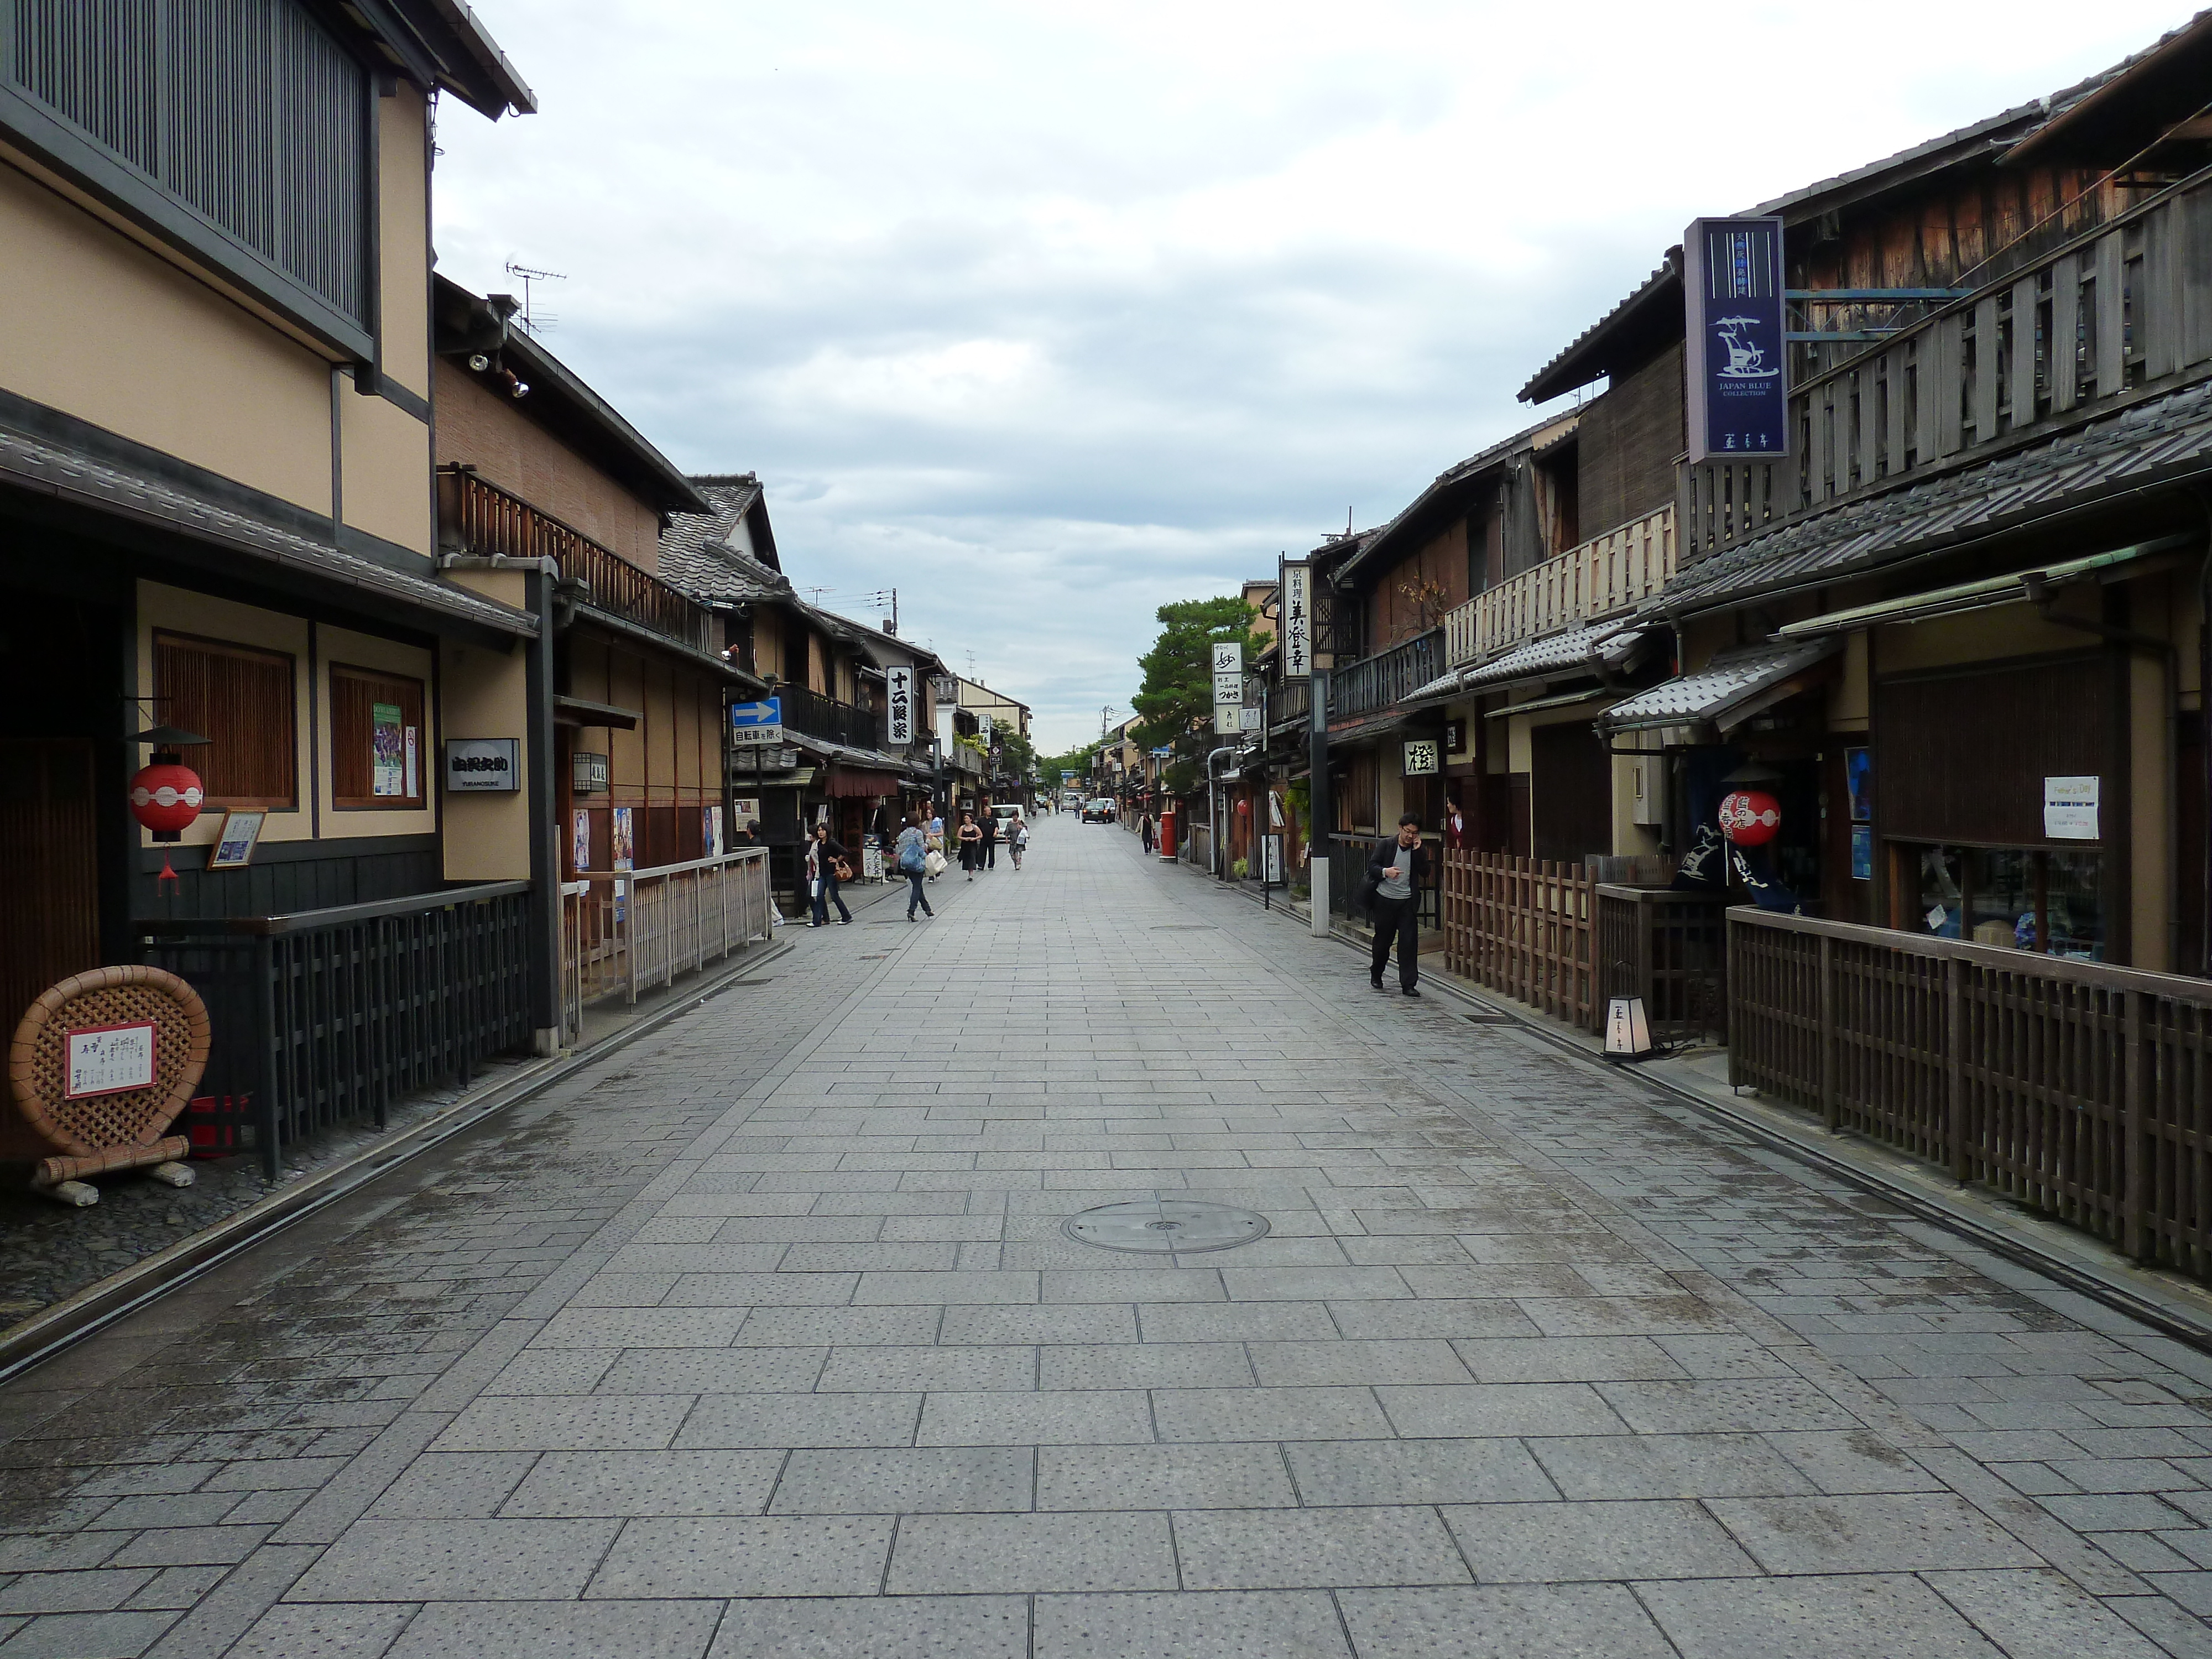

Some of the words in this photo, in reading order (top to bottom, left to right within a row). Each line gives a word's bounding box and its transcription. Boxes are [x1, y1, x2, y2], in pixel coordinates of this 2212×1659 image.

[1292, 568, 1302, 599] 京料理
[1287, 600, 1310, 675] 美登幸
[891, 671, 908, 739] 十二段家
[736, 729, 780, 741] 自転車を除く
[1408, 744, 1434, 771] 橙
